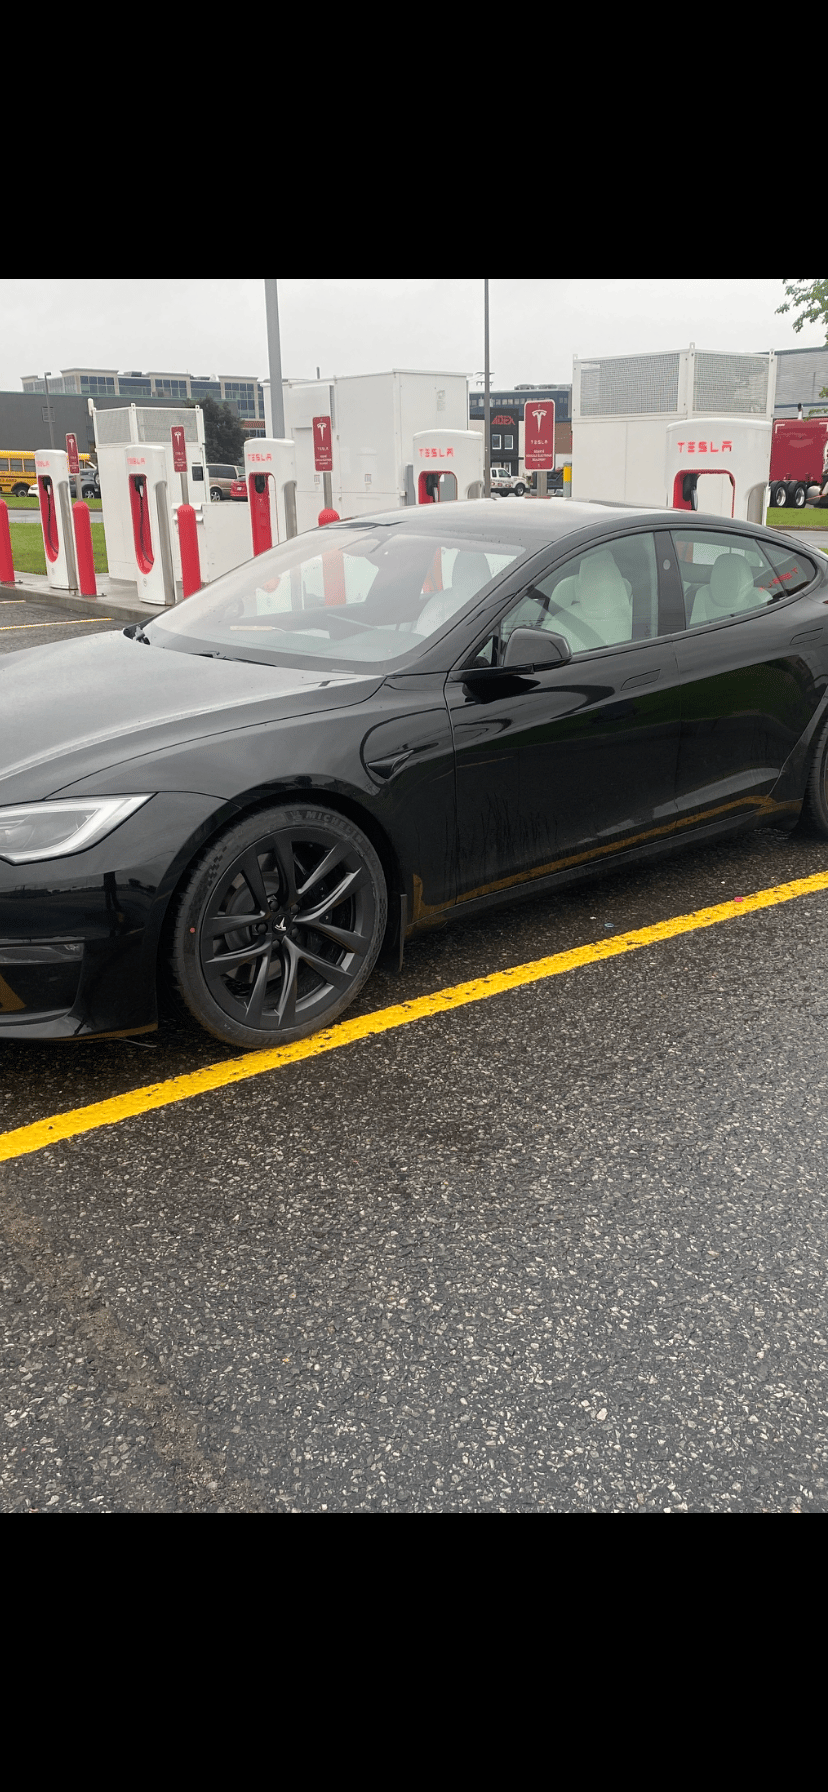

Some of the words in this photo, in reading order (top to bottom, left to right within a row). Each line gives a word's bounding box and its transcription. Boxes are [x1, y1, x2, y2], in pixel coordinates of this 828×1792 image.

[418, 447, 454, 458] TESLA
[677, 440, 732, 453] TESLA
[247, 453, 272, 462] TESLA
[306, 811, 364, 844] MICHELIN
